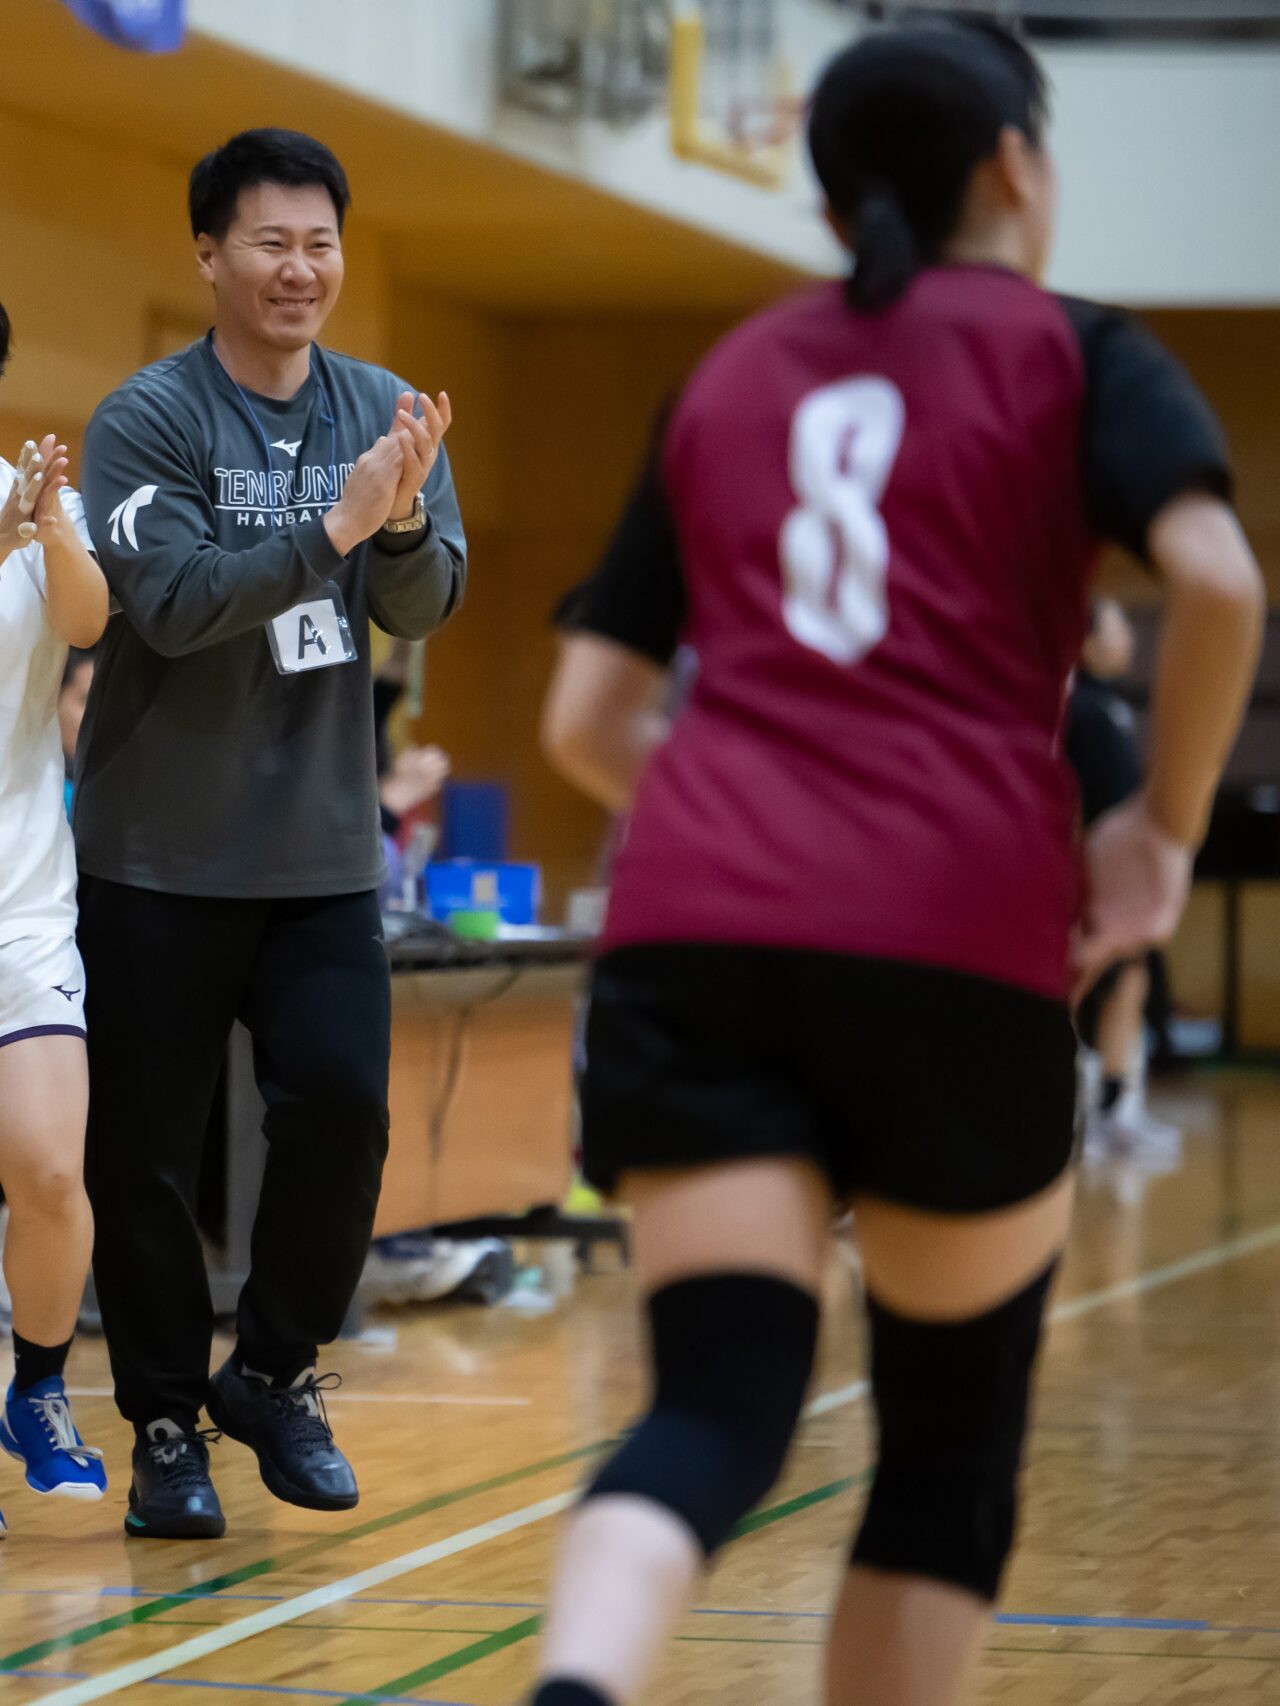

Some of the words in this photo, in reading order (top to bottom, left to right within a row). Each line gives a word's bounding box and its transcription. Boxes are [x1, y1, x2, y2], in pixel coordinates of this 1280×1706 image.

[236, 508, 322, 527] HANBA
[778, 373, 907, 665] 8
[298, 614, 327, 659] A
